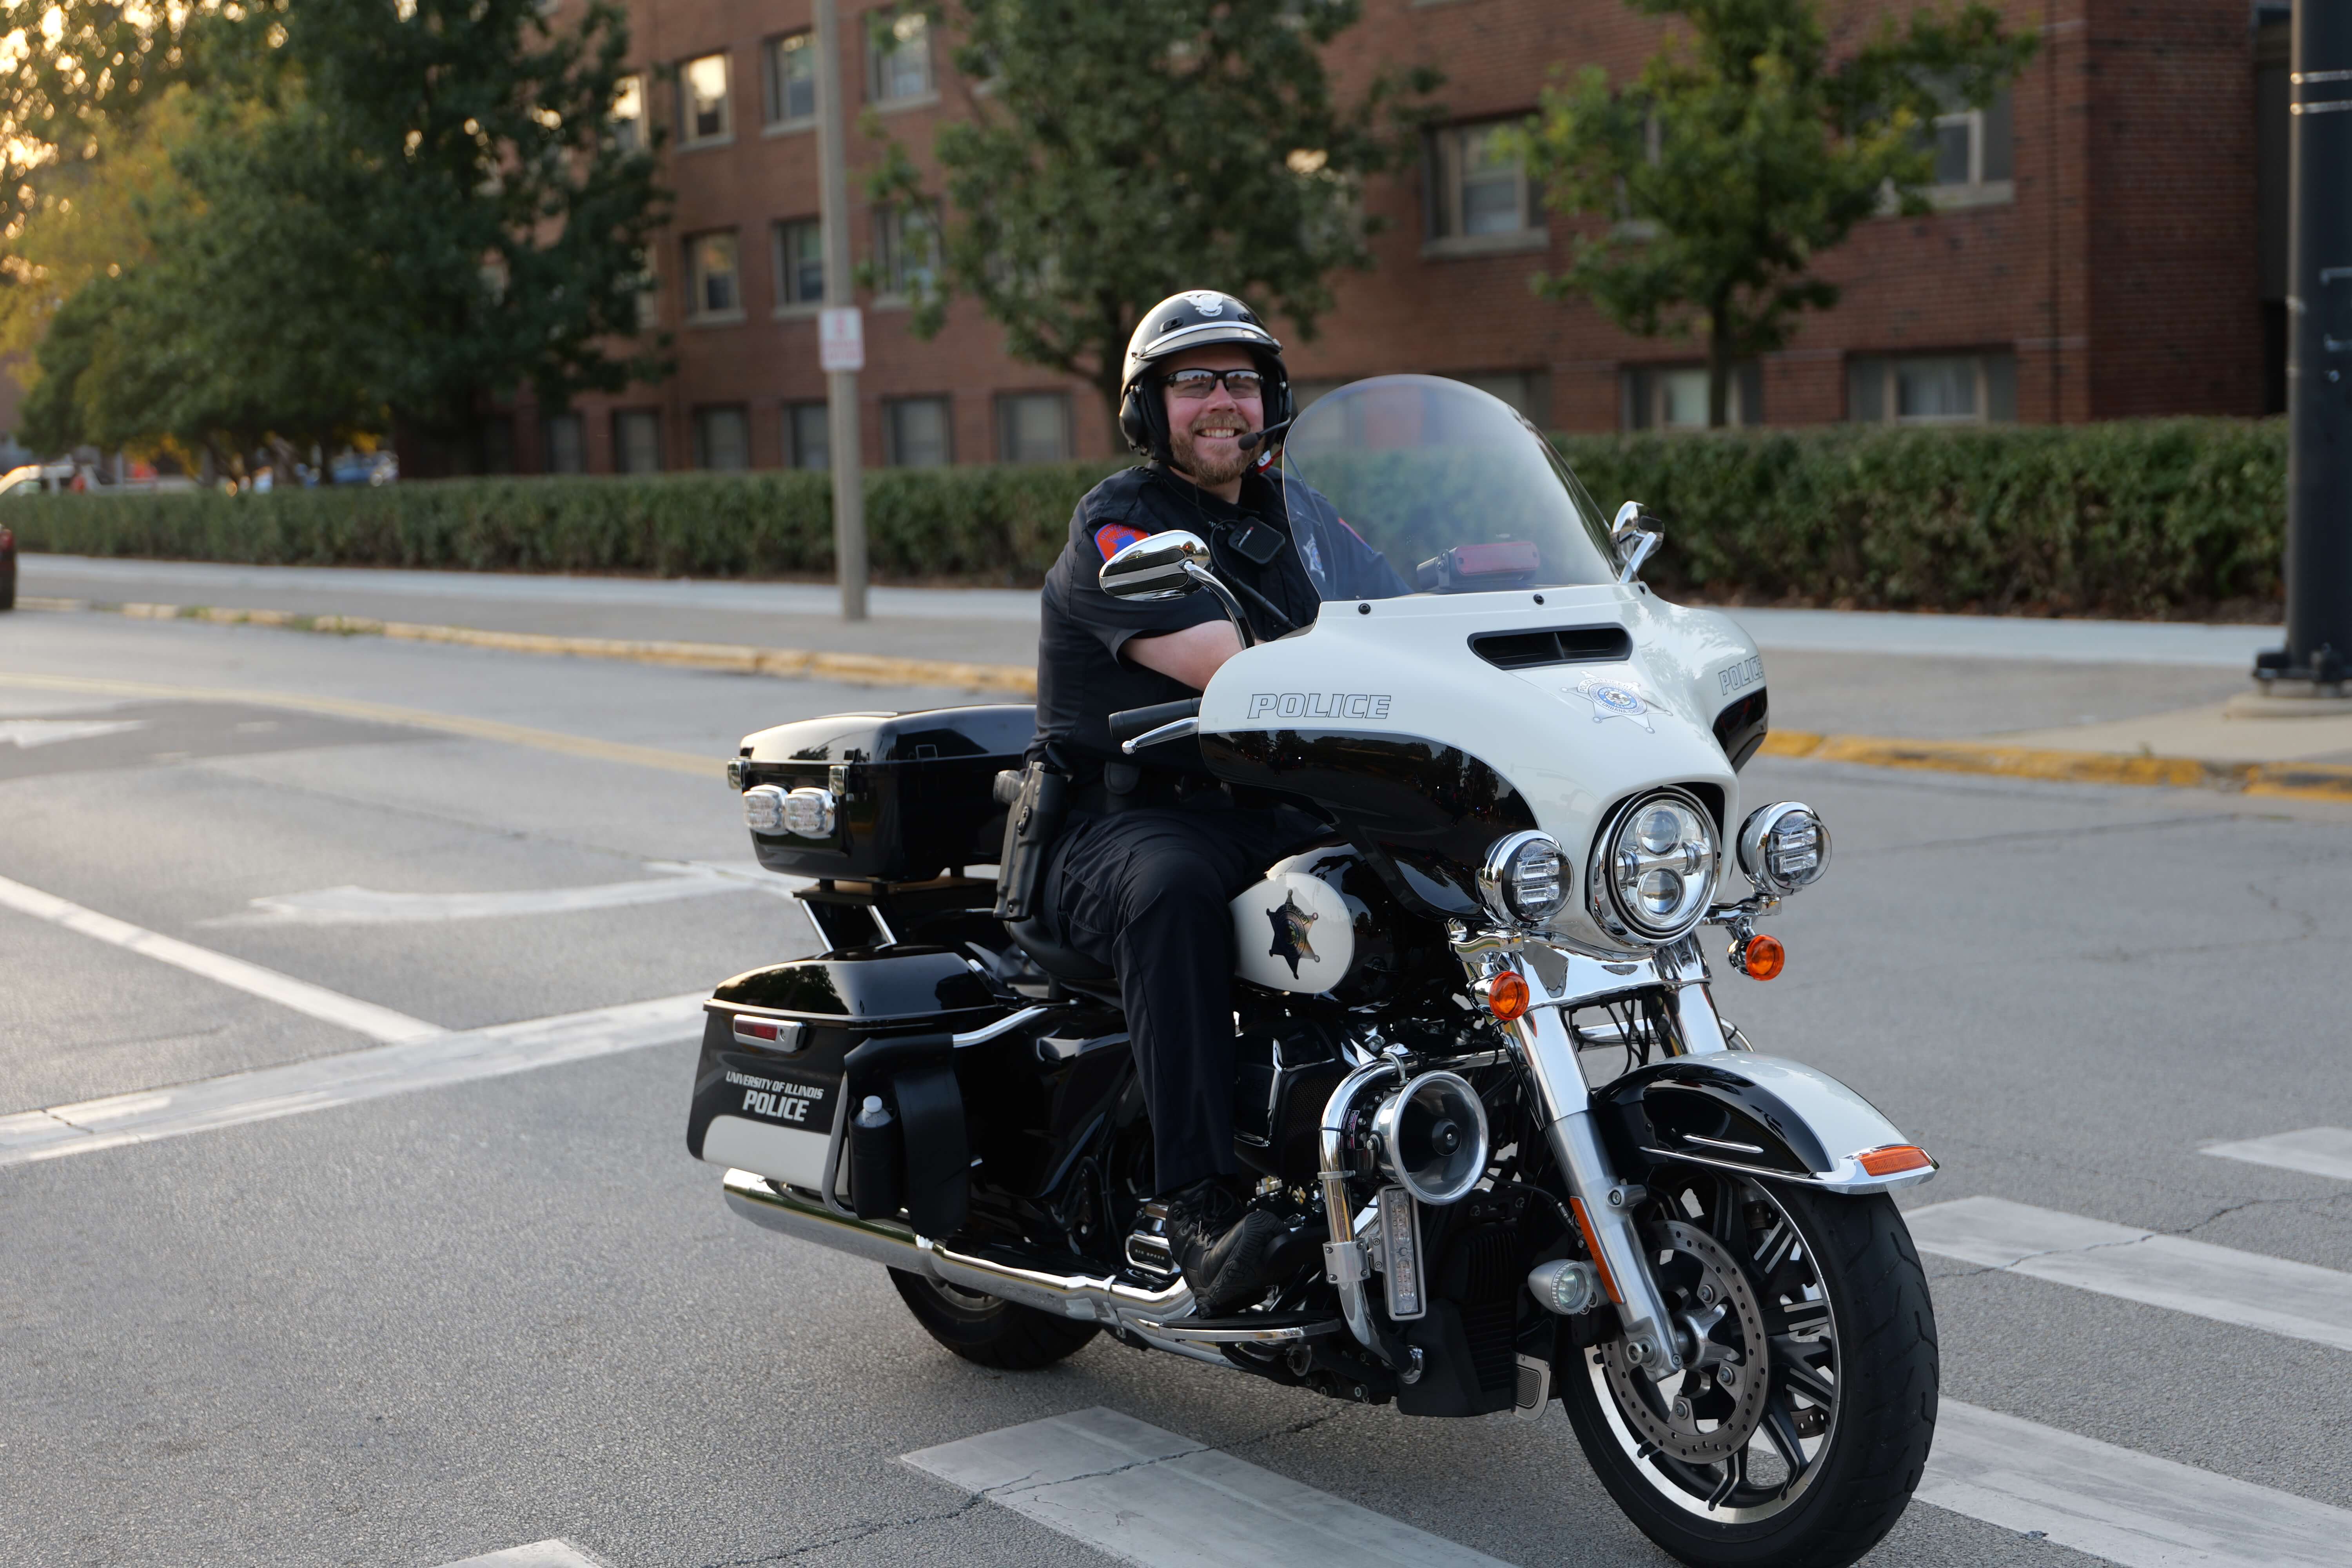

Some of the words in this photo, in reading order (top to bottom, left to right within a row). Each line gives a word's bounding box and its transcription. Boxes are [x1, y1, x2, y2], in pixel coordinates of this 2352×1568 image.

[1107, 529, 1135, 543] ILLINOIS
[1718, 655, 1763, 696] POLICE
[1247, 693, 1391, 719] POLICE
[1288, 904, 1307, 923] OFFICER
[726, 1071, 773, 1091] UNIVERSITY
[771, 1080, 786, 1093] OF
[784, 1083, 825, 1100] ILLINOIS
[742, 1089, 810, 1122] POLICE
[1146, 1252, 1165, 1261] SPEED
